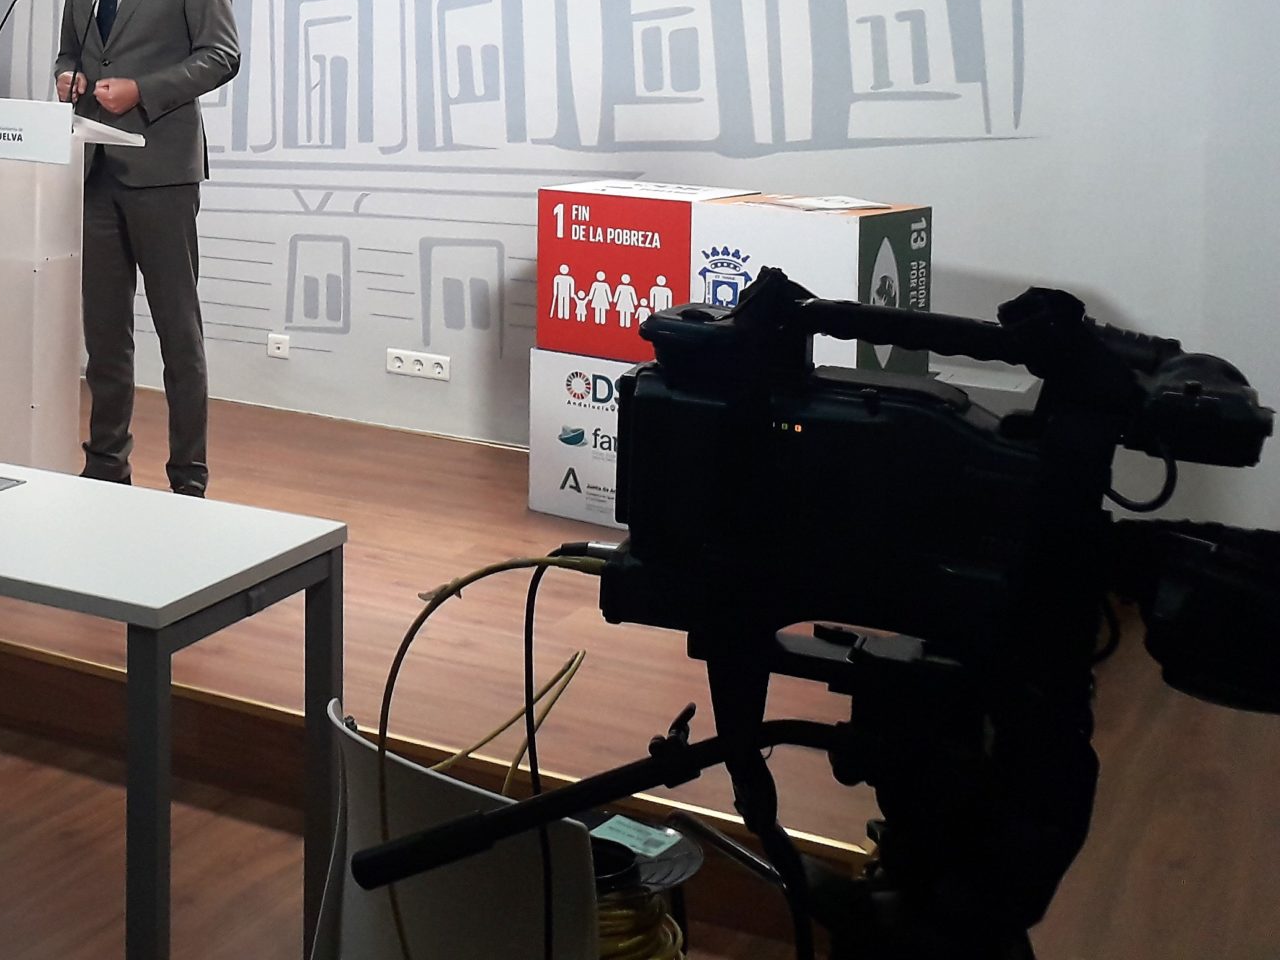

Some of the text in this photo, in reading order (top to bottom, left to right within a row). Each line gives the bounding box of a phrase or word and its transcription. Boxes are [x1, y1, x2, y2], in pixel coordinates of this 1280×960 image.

[553, 203, 590, 239] 1 FIN
[571, 224, 661, 249] DE LA POBREZA
[910, 217, 927, 250] 13
[909, 261, 918, 305] POR EL
